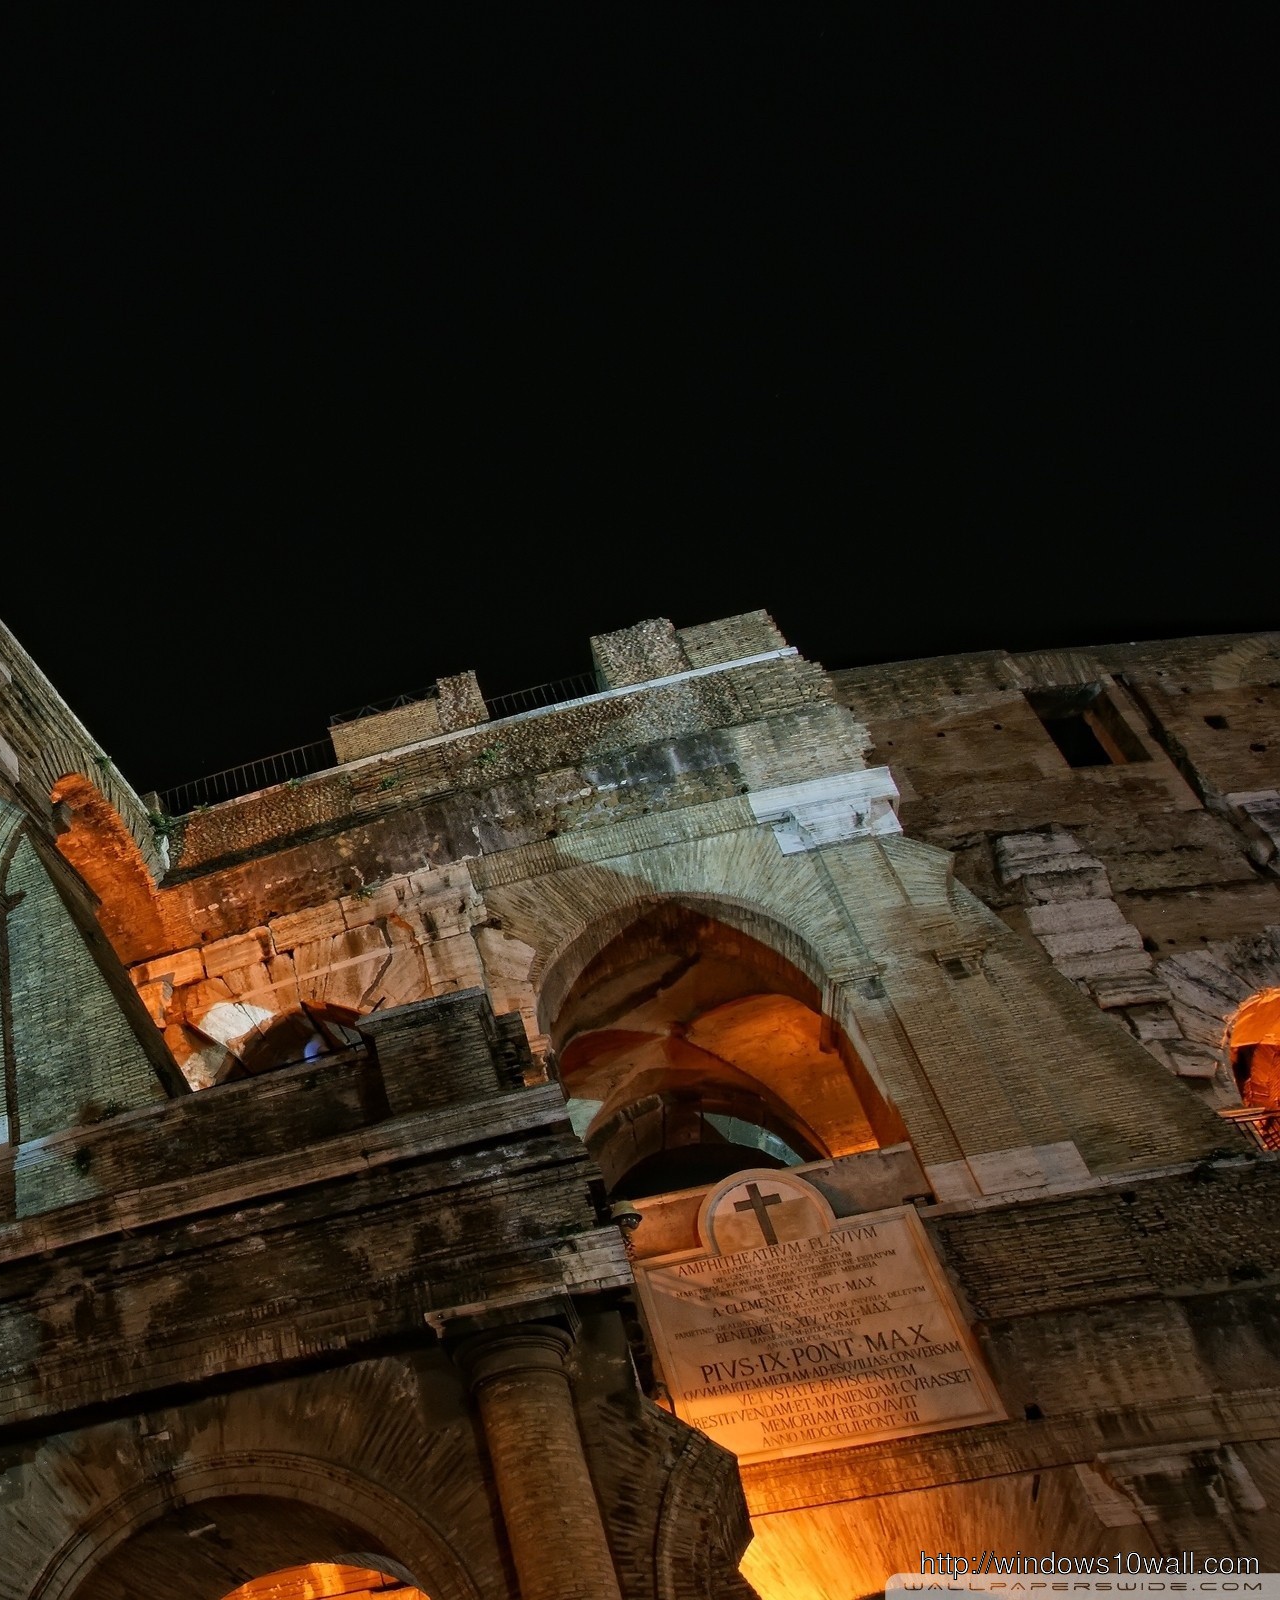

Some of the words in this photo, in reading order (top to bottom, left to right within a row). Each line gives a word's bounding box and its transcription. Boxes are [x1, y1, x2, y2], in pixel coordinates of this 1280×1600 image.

[676, 1242, 801, 1278] AMPHITHEATRVM
[808, 1226, 877, 1250] FLAVIVM
[712, 1308, 722, 1318] A
[725, 1294, 791, 1315] CLEMENTE
[795, 1291, 805, 1301] X
[809, 1284, 842, 1298] PONT
[846, 1277, 877, 1291] MAX
[716, 1320, 792, 1344] BENEDICTVS
[795, 1315, 818, 1328] XIV
[823, 1308, 857, 1323] PONT
[860, 1301, 892, 1316] MAX
[683, 1386, 718, 1403] QVVM
[719, 1378, 763, 1395] PARTEM
[763, 1370, 810, 1387] MEDIAM
[810, 1366, 829, 1378] AD
[830, 1355, 889, 1375] ESQVILIAS
[889, 1341, 962, 1364] CONVERSAM
[700, 1358, 755, 1384] PIVS
[759, 1352, 788, 1373] IX
[791, 1338, 858, 1367] PONT
[863, 1324, 931, 1353] MAX
[693, 1401, 793, 1431] RESTITVENDAM
[794, 1398, 813, 1412] ET
[815, 1383, 898, 1409] MVNIENDAM
[899, 1369, 973, 1394] CVRASSET
[737, 1382, 819, 1407] VETVSTATE
[820, 1364, 917, 1392] FATISCENTEM
[761, 1409, 839, 1434] MEMORIAM
[840, 1395, 920, 1420] RENOVAVIT
[761, 1433, 799, 1448] ANNO
[800, 1421, 862, 1442] MDCCCLII
[862, 1415, 898, 1430] PONT
[901, 1411, 920, 1423] VII
